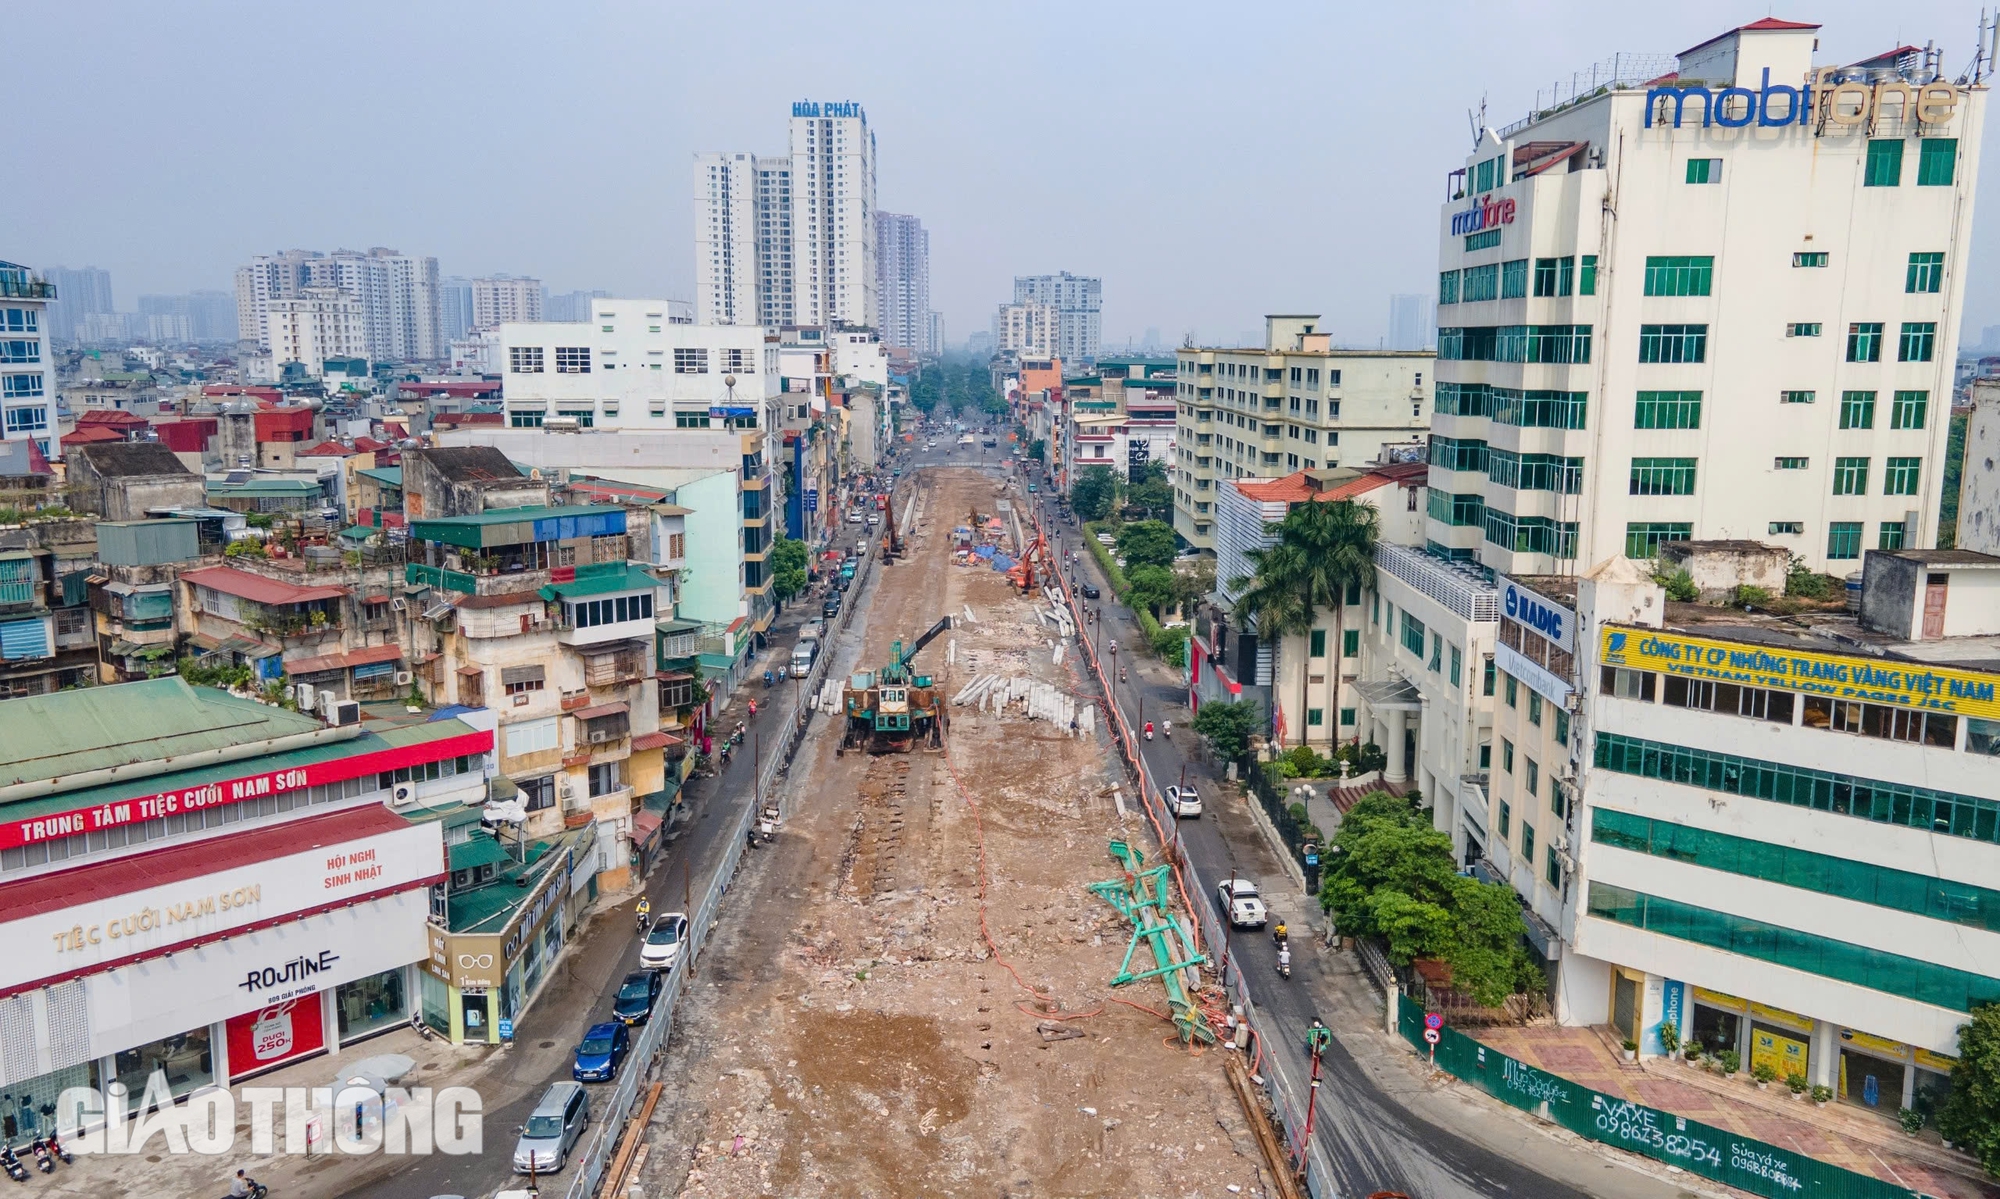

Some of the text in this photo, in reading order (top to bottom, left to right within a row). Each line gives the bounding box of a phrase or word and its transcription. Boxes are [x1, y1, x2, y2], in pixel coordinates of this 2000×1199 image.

[792, 98, 859, 117] HÒA PHÁT
[1645, 65, 1958, 129] mobifone
[1451, 194, 1516, 236] mobifone
[1508, 651, 1556, 700] Vietcombank
[1640, 636, 1680, 660] CÔNG
[1683, 645, 1704, 662] TY
[1707, 648, 1726, 665] CP
[1729, 651, 1788, 675] NHỮNG
[1790, 658, 1848, 682] TRANG
[1852, 664, 1900, 690] VÀNG
[1904, 671, 1946, 696] VIỆT
[1949, 678, 1995, 702] NAM
[1667, 662, 1957, 711] VIETNAM YELLOW PAGES JSC
[21, 769, 307, 841] TRUNG TÂM TIỆC CƯỚI NAM SƠN
[324, 864, 383, 889] SINH NHẬT
[327, 848, 376, 870] HỘI NGHỊ
[53, 884, 262, 952] TIỆC CƯỚI NAM SƠN
